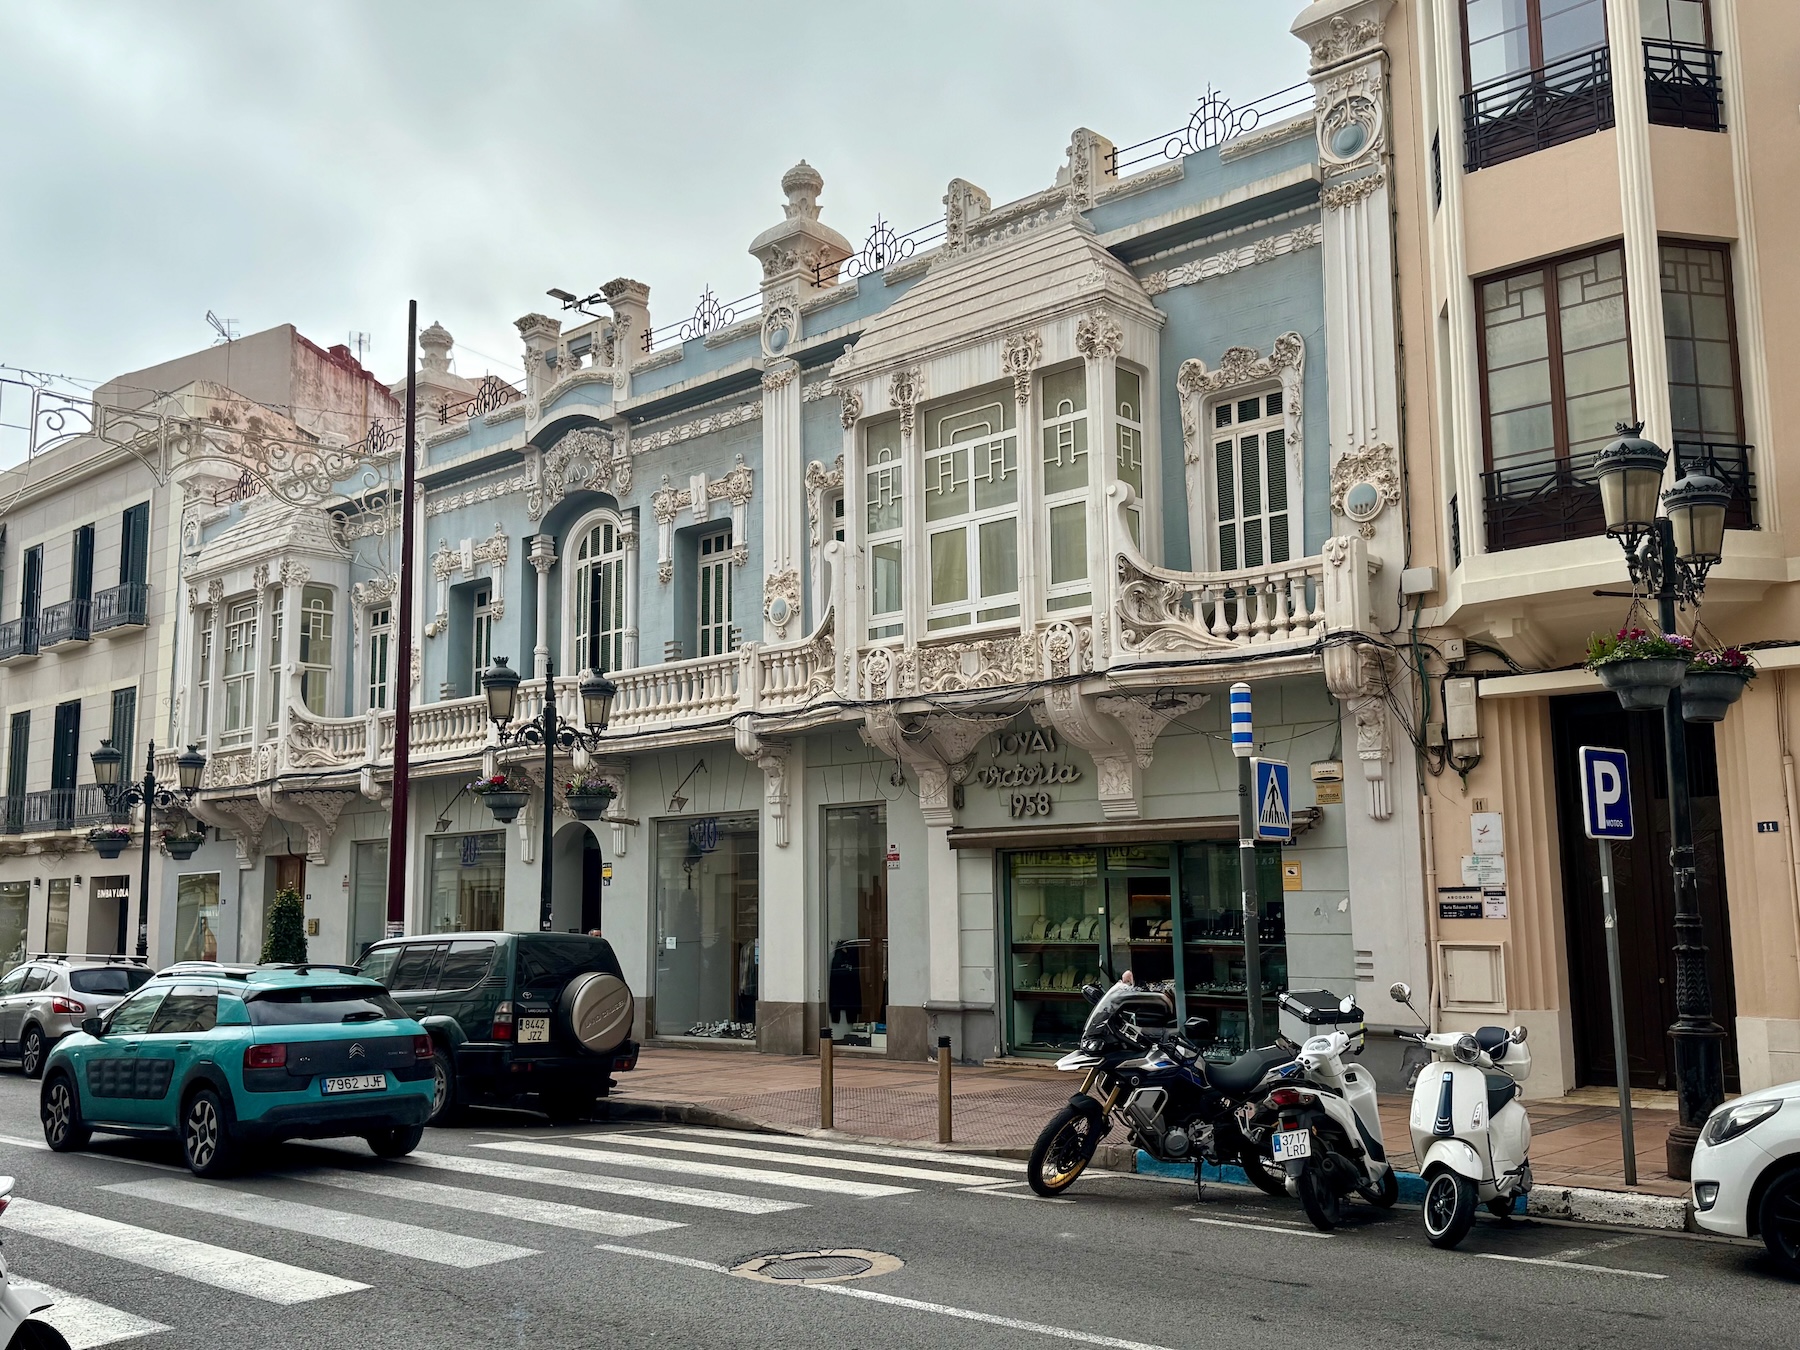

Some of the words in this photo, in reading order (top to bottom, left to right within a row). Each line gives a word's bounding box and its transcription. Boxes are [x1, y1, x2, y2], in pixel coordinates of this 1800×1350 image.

[1593, 760, 1622, 829] P
[1008, 792, 1051, 818] 1958
[1475, 800, 1483, 811] 11
[1606, 818, 1624, 828] MOTOS
[1763, 822, 1774, 831] 11
[698, 818, 717, 848] 20
[462, 836, 476, 863] 20
[112, 888, 117, 898] Y
[116, 887, 129, 898] LOLA
[525, 1019, 545, 1029] 8442
[527, 1031, 542, 1041] JZZ
[328, 1077, 359, 1091] 7962
[363, 1075, 383, 1088] JJF
[1282, 1131, 1307, 1146] 3717
[1286, 1144, 1306, 1157] LRD
